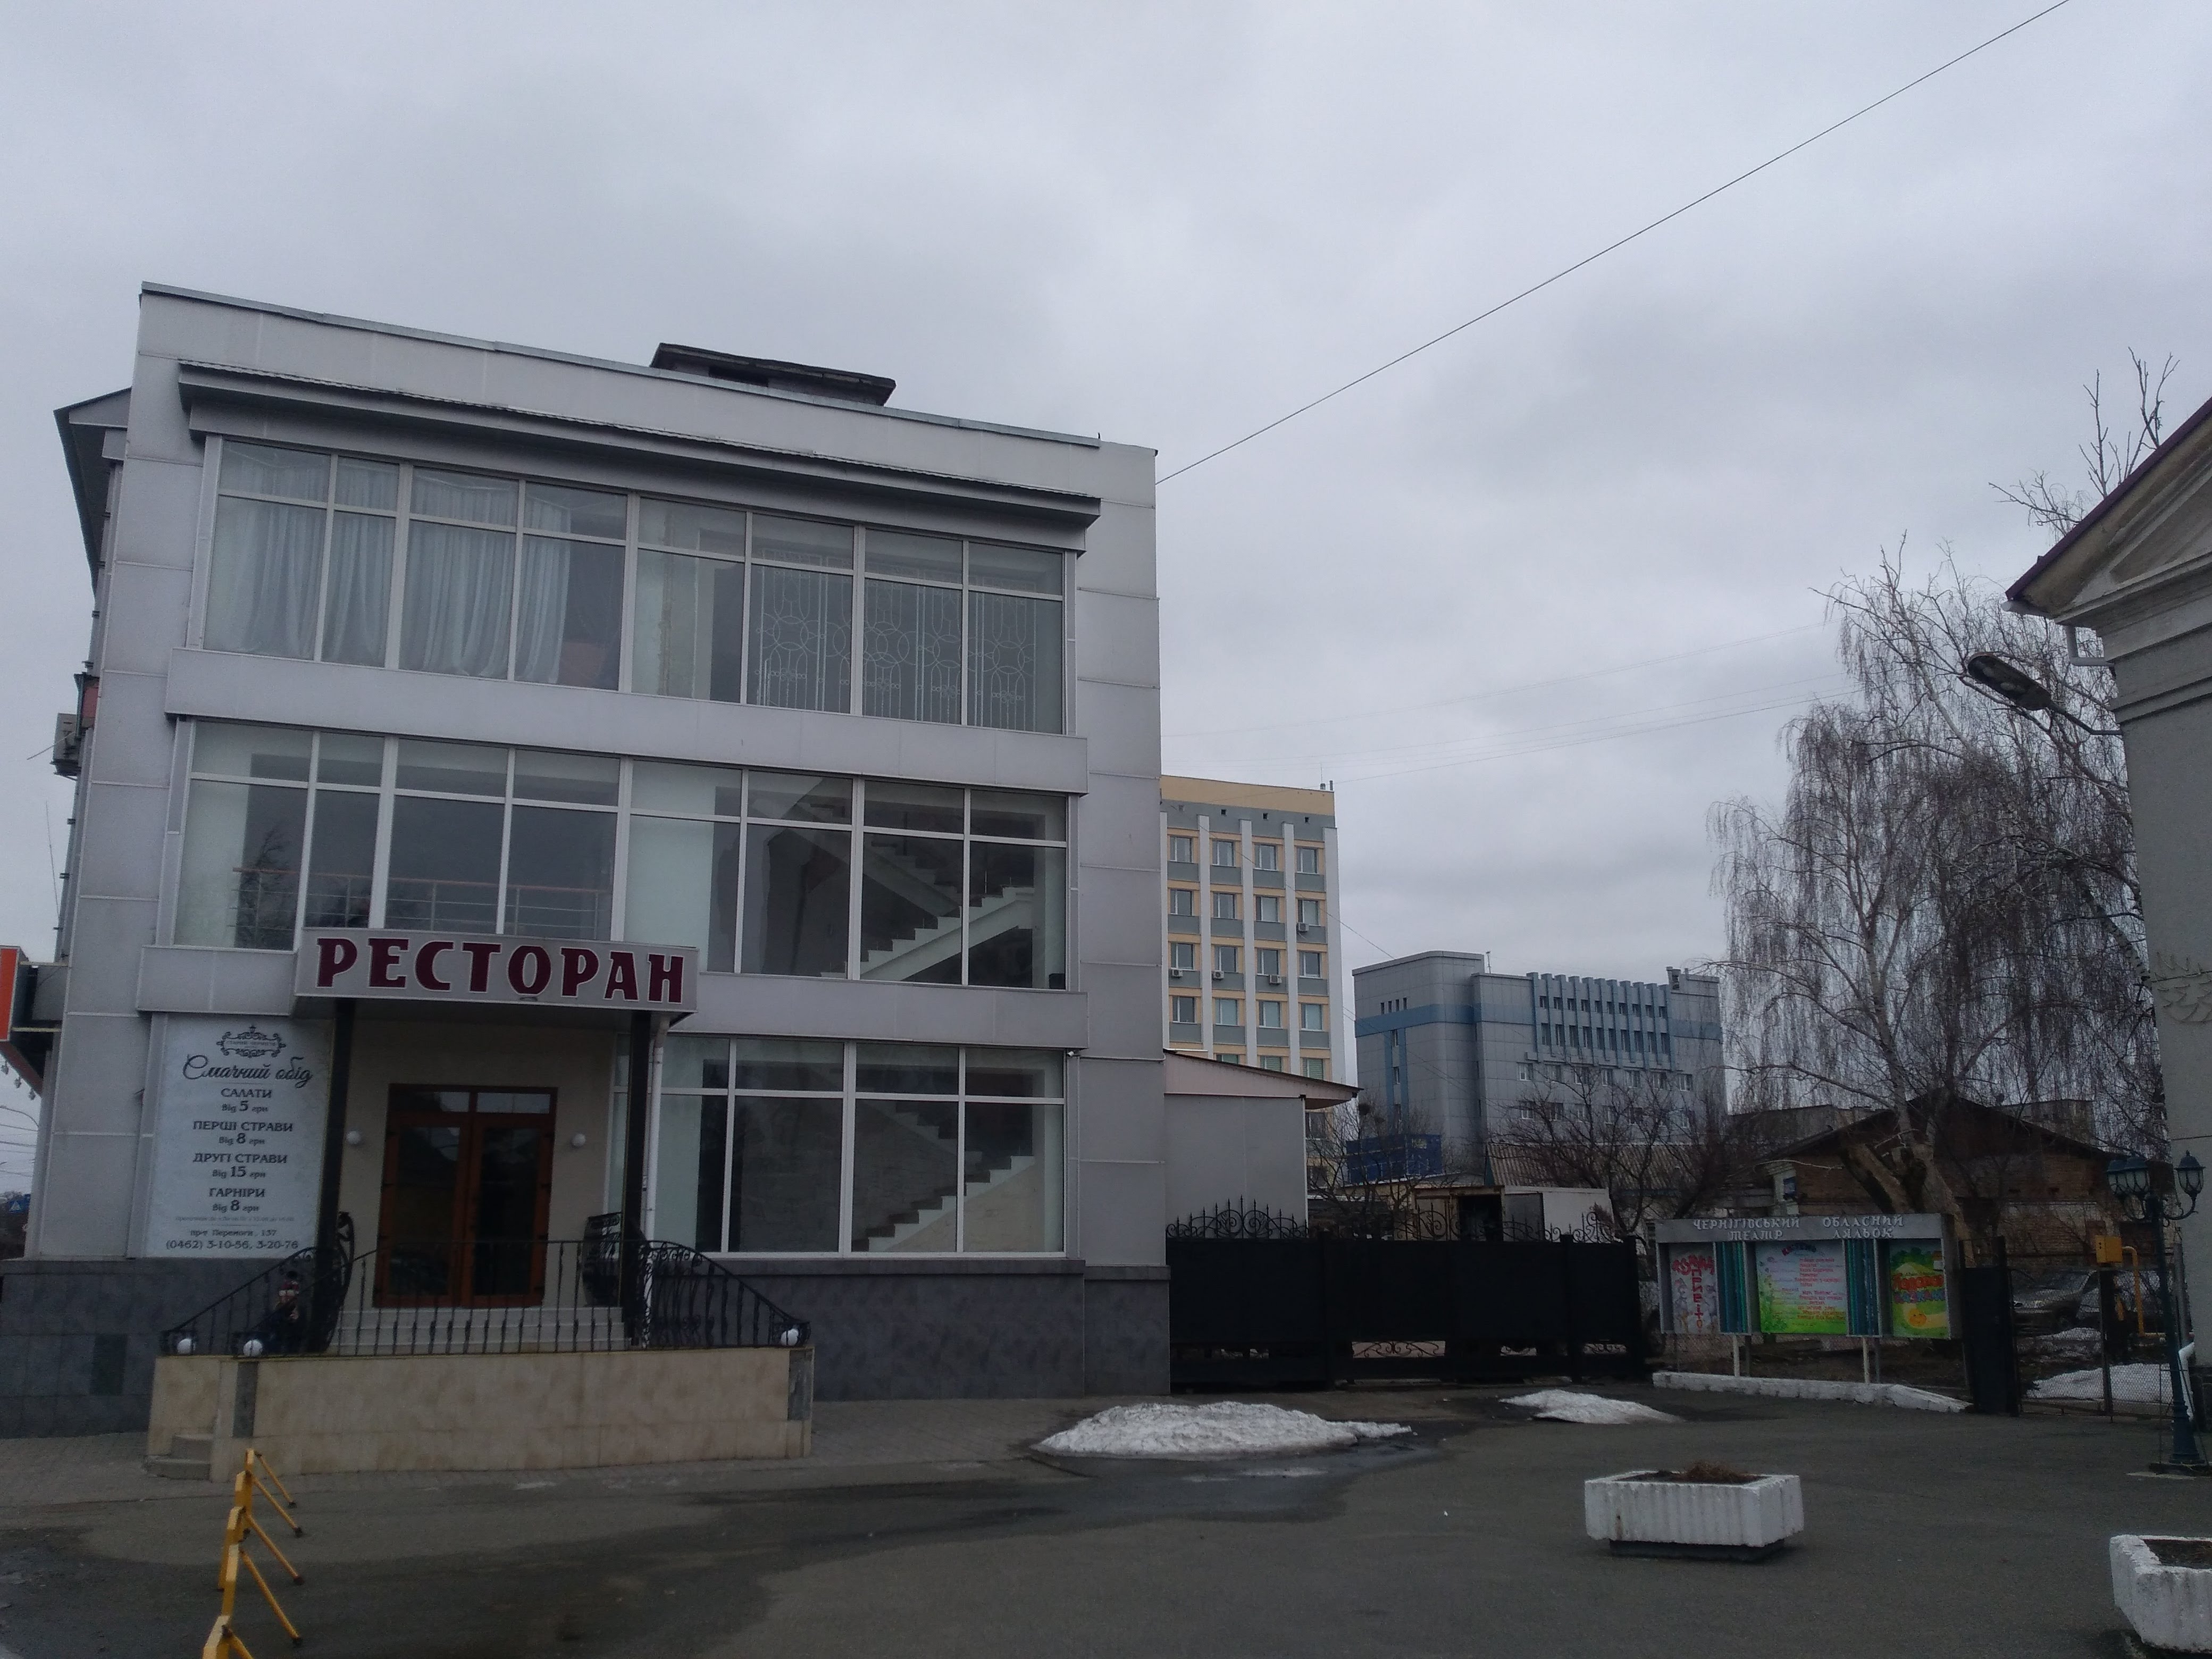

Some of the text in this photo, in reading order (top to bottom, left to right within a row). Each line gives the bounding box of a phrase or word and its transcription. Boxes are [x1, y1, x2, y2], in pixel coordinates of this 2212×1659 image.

[316, 937, 684, 1004] РЕСТОРАН
[183, 1054, 313, 1088] Смачний обід
[221, 1088, 272, 1098] САЛАТИ
[239, 1100, 248, 1111] 5
[193, 1120, 293, 1132] ПЕРШІ СТРАВИ
[237, 1133, 246, 1144] 8
[193, 1153, 288, 1163] ДРУГІ СТРАВИ
[230, 1166, 246, 1177] 15
[209, 1188, 265, 1197] ГАРНІРИ
[230, 1200, 240, 1211] 8
[1693, 1214, 1904, 1230] ЧЕРНІГІВСЬКИЙ ОБЛАСНИЙ
[1727, 1226, 1893, 1241] ТЕАТР ЛЯЛЬОК
